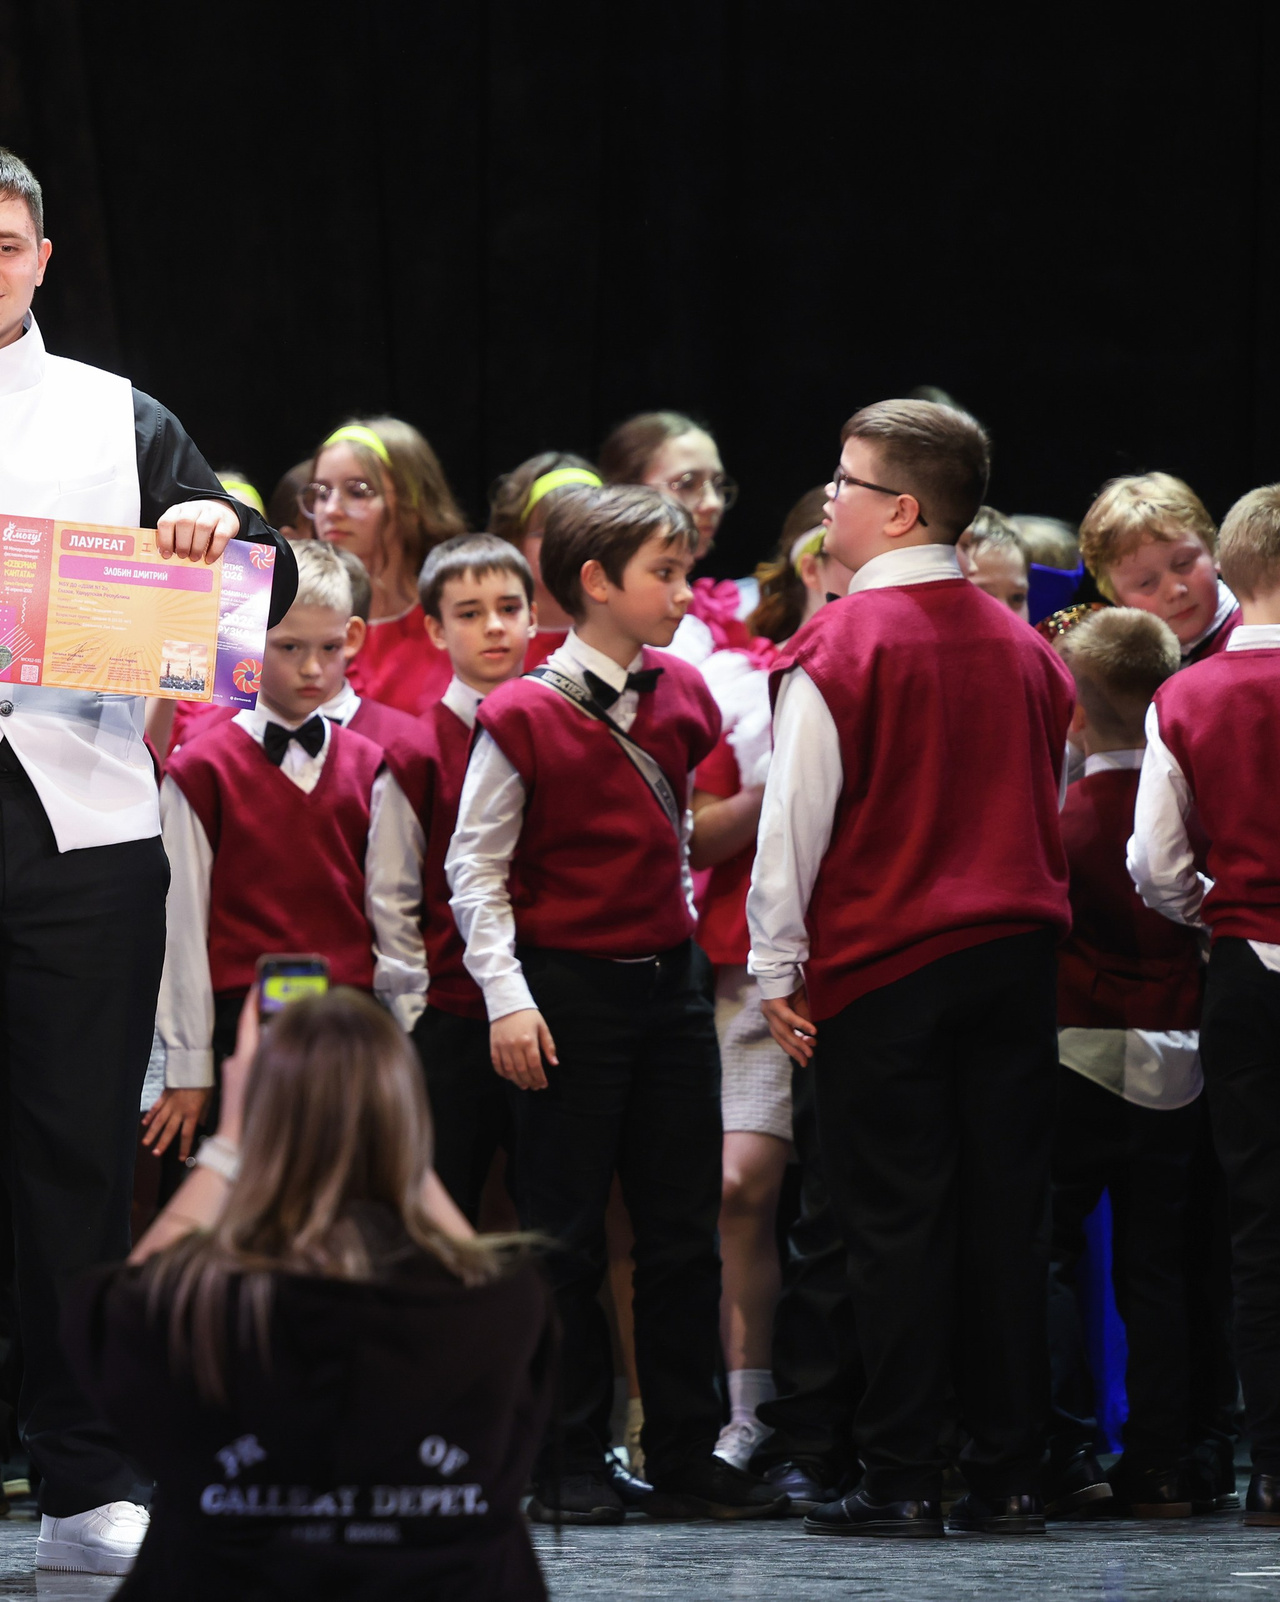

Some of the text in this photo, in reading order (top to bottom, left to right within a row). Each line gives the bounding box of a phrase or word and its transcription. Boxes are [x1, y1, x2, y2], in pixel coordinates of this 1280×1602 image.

[2, 527, 42, 546] Я могу!
[69, 534, 126, 552] ЛАУРЕАТ
[3, 559, 37, 570] «СЕВЕРНАЯ
[4, 569, 35, 578] КАНТАТА»
[103, 566, 168, 582] ЗЛОБИН ДМИТРИЙ
